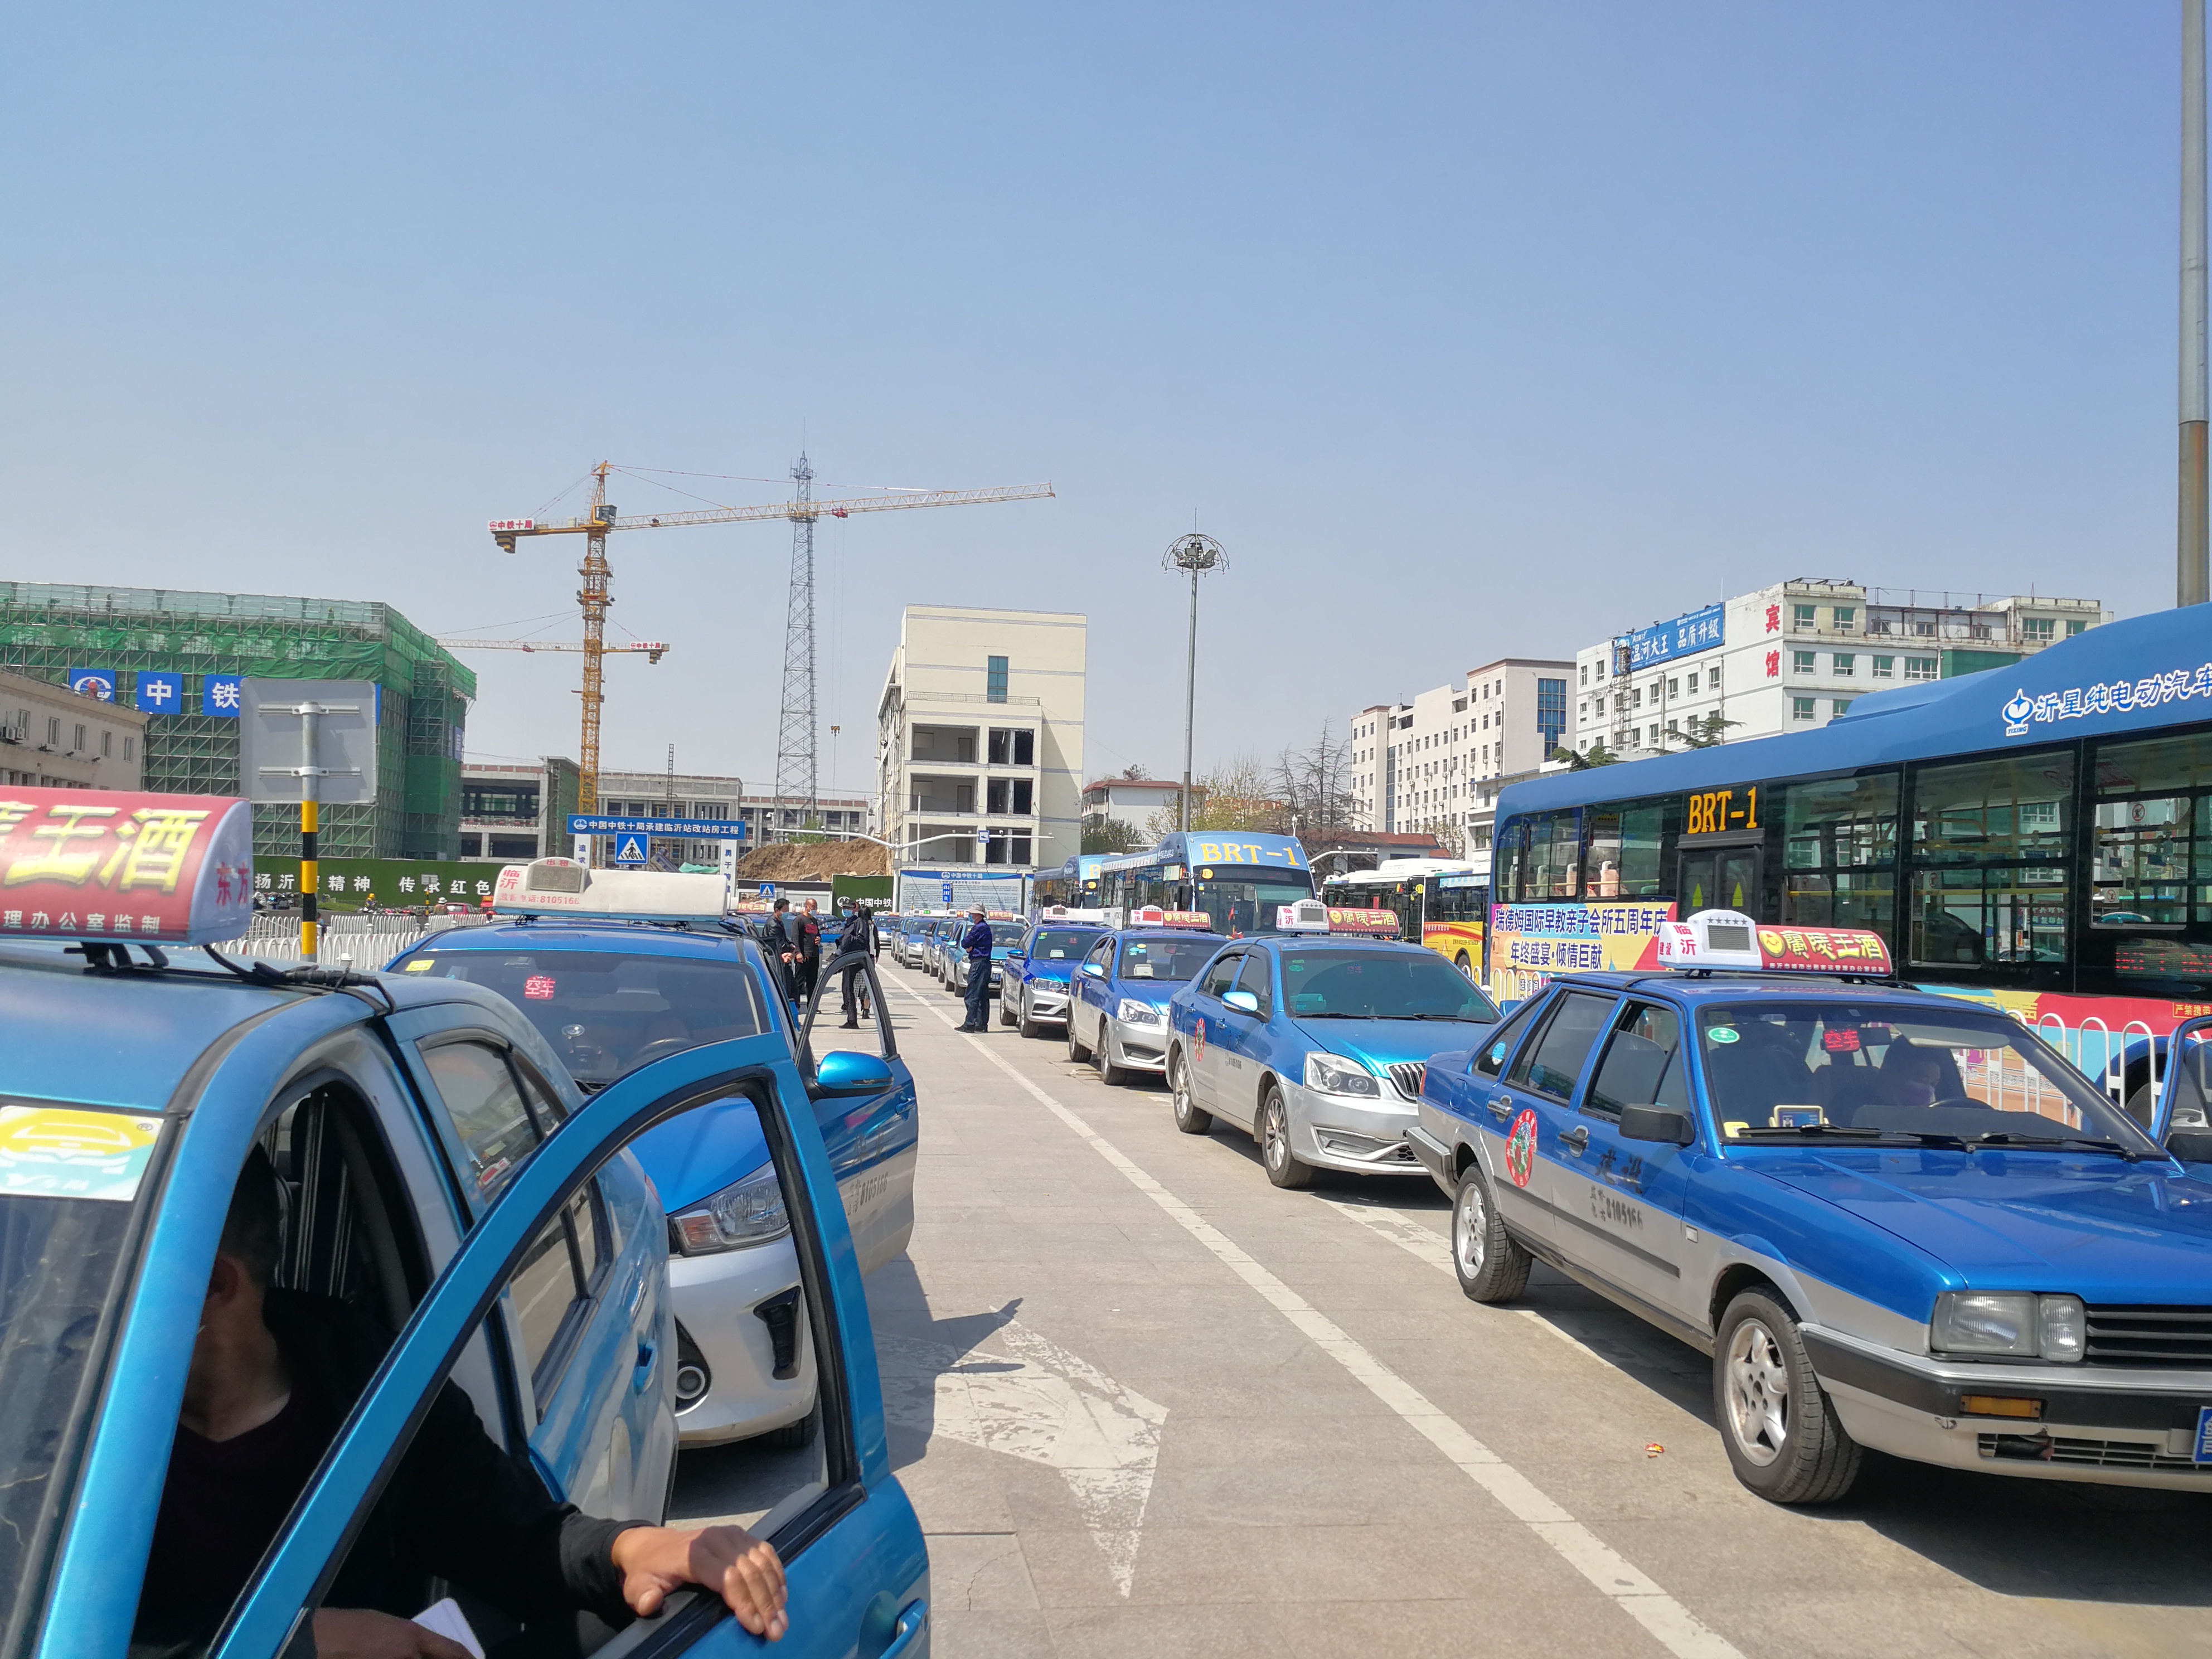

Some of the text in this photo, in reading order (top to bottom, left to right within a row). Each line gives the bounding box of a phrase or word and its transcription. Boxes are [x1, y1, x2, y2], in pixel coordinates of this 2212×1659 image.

[1677, 618, 1720, 649] 品质升级
[1765, 604, 1780, 678] 宾馆
[1687, 786, 1758, 835] BRT-1
[1201, 843, 1300, 866] BRT-1
[255, 873, 370, 892] 扬沂精神
[856, 898, 892, 908] 中国中铁
[3, 910, 161, 934] 理办公室监制
[1495, 907, 1667, 938] 瑞德姆国际早教亲子会所五周年庆
[1673, 925, 1697, 956] 临沂
[860, 1171, 888, 1206] 8105166
